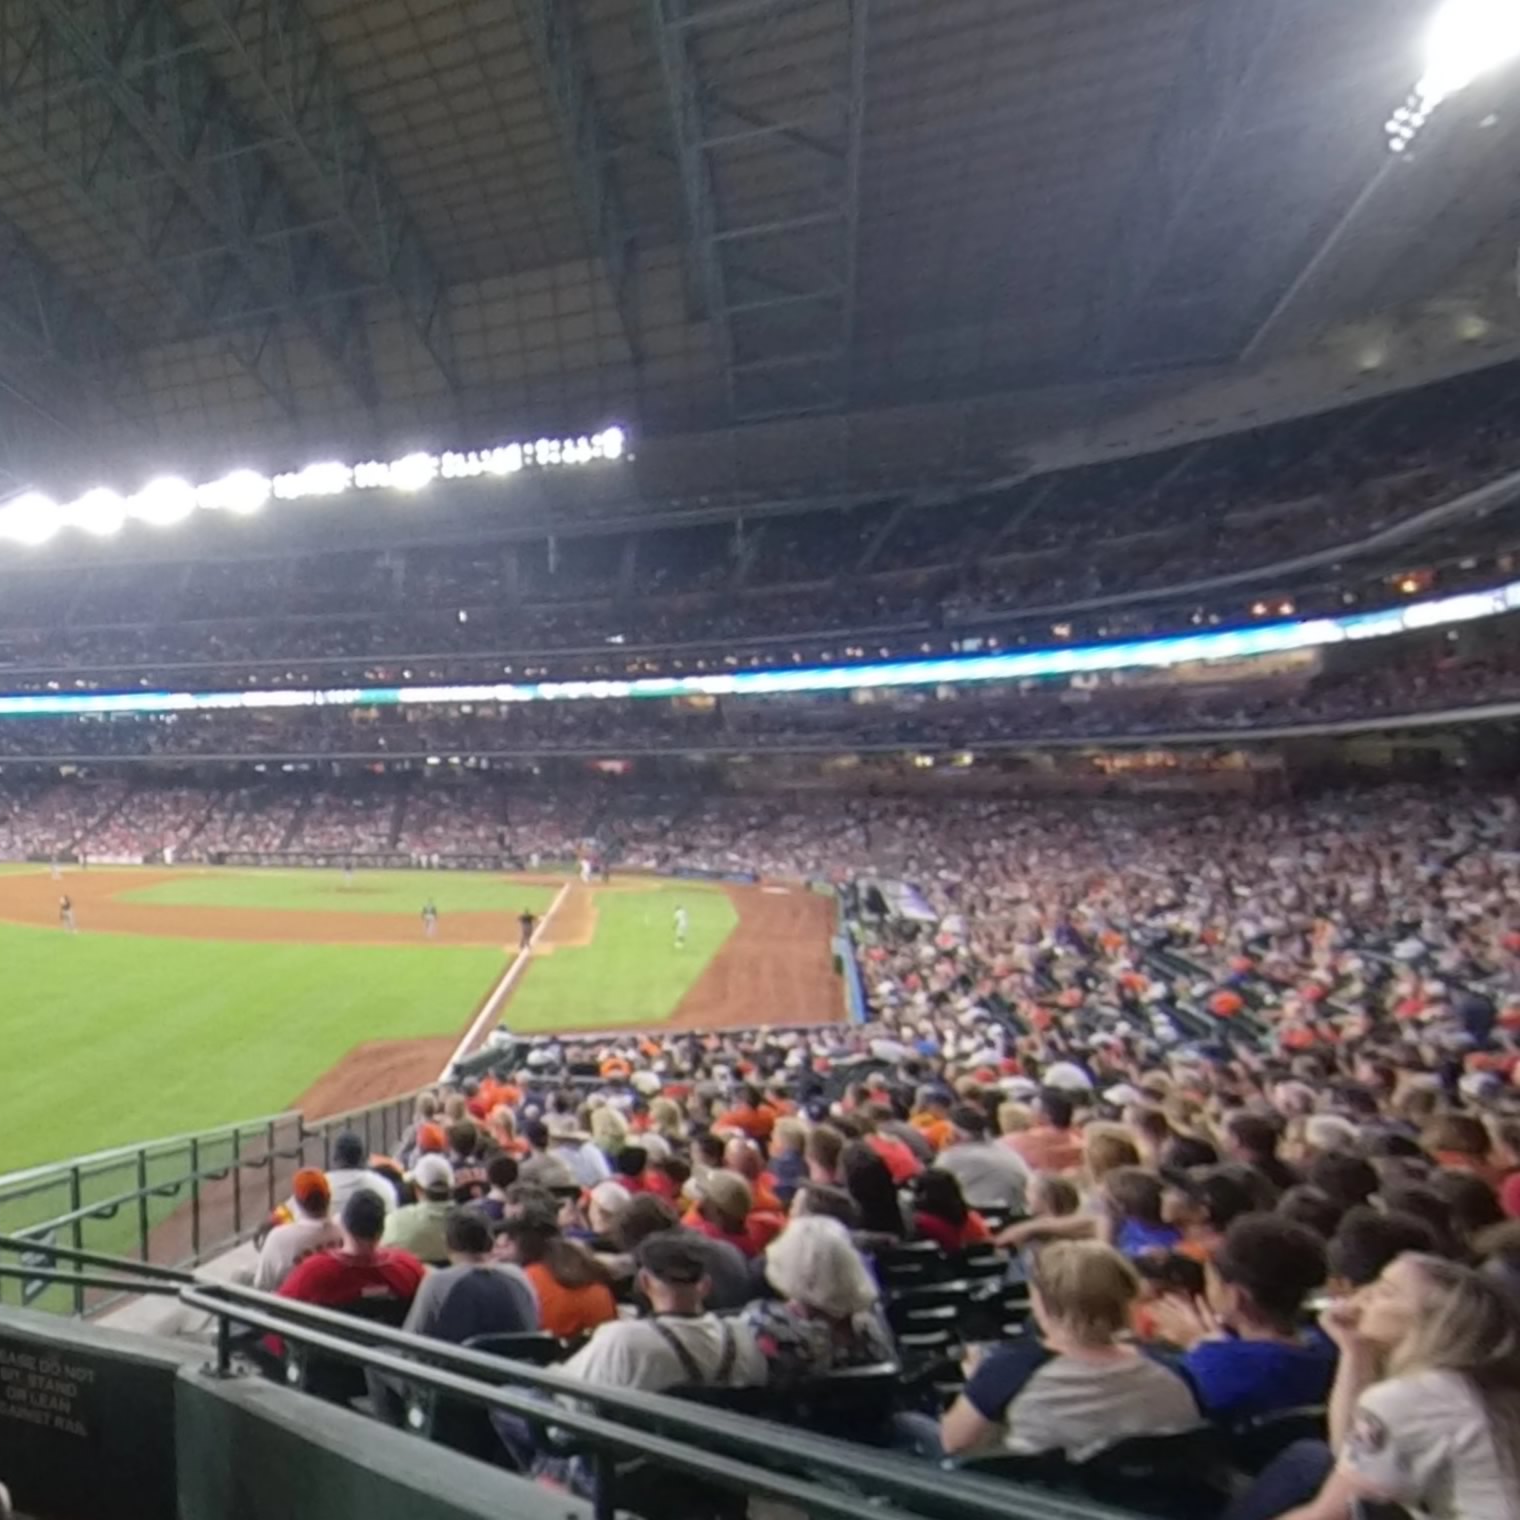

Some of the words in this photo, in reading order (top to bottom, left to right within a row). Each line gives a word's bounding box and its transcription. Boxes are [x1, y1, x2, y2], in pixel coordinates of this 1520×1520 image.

[39, 1359, 61, 1377] DO
[64, 1364, 94, 1384] NOT
[27, 1373, 78, 1398] STAND
[6, 1386, 27, 1401] OR
[29, 1392, 72, 1415] LEAN
